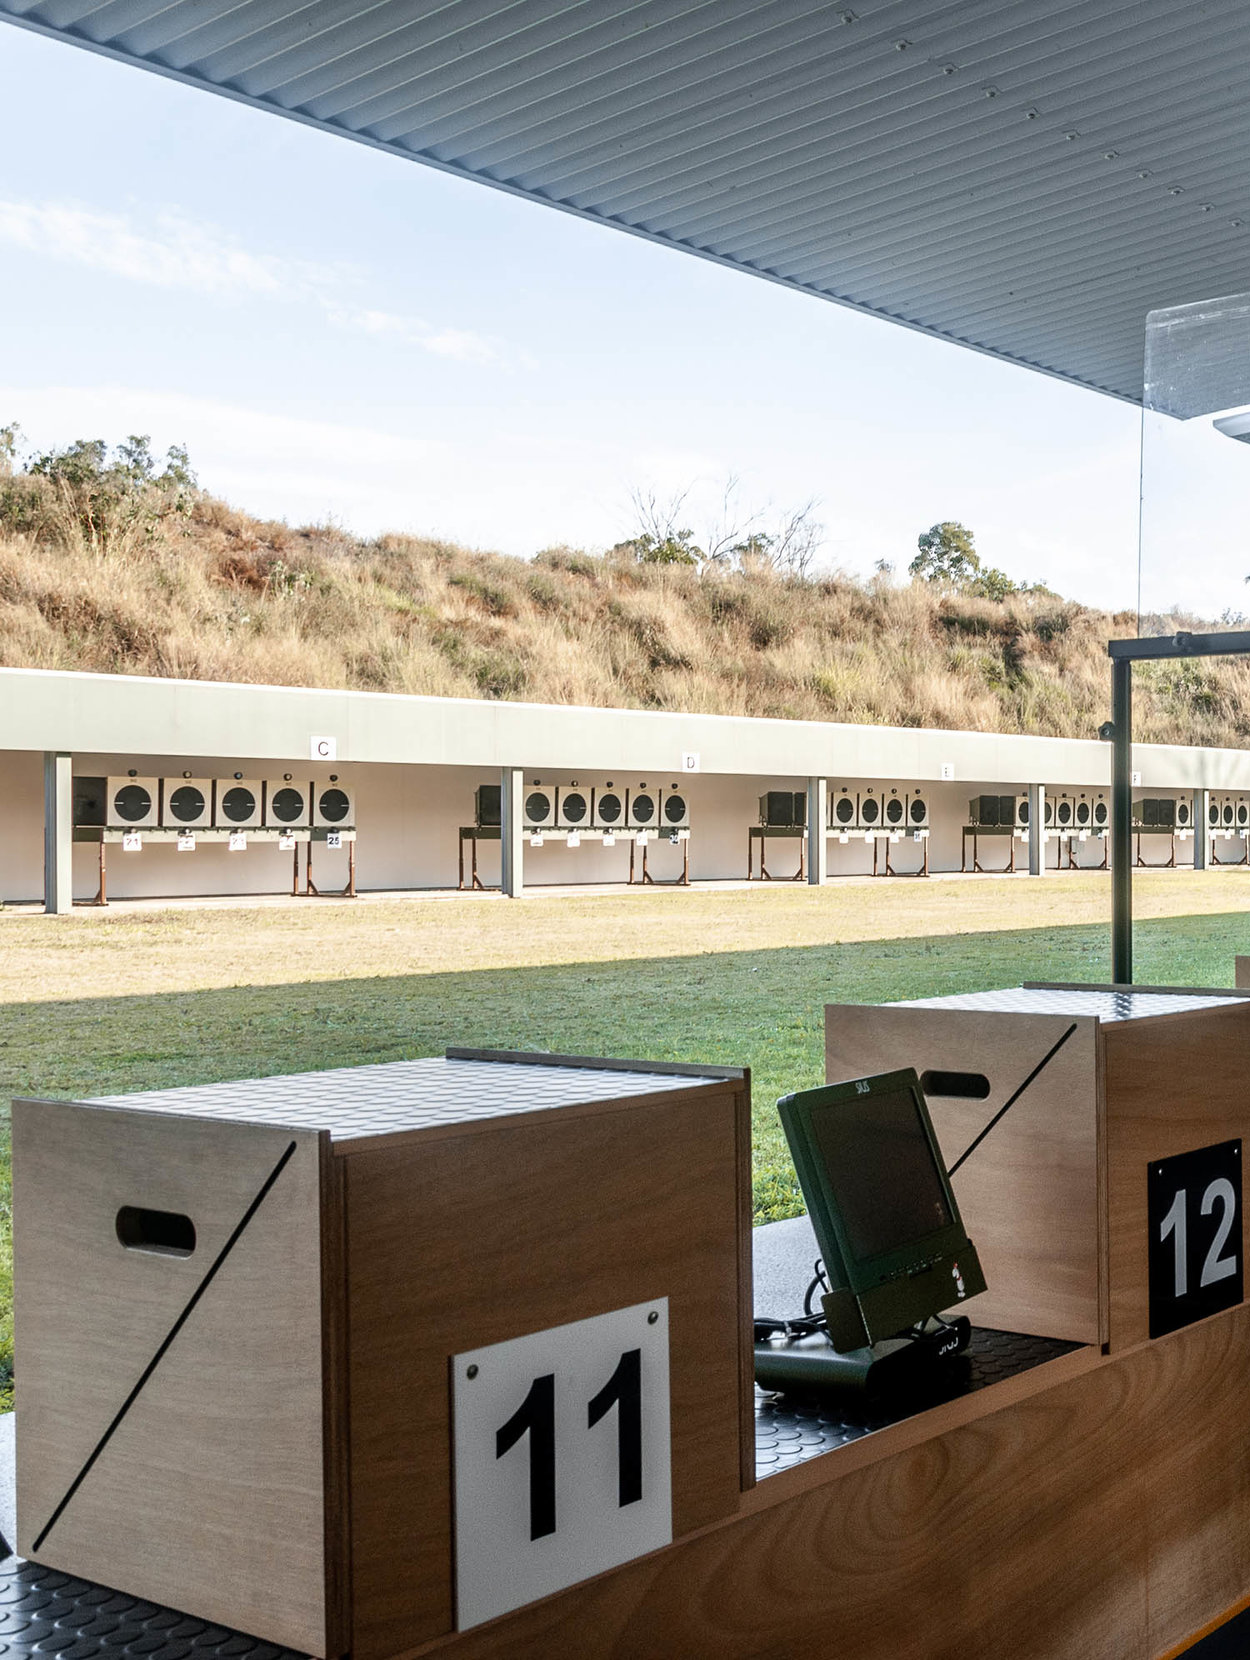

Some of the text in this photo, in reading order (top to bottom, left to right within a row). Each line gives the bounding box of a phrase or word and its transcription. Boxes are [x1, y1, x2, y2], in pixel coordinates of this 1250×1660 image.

[318, 741, 329, 756] C
[687, 756, 695, 769] D
[328, 836, 340, 846] 25
[1160, 1177, 1238, 1298] 12
[495, 1347, 643, 1542] 11
